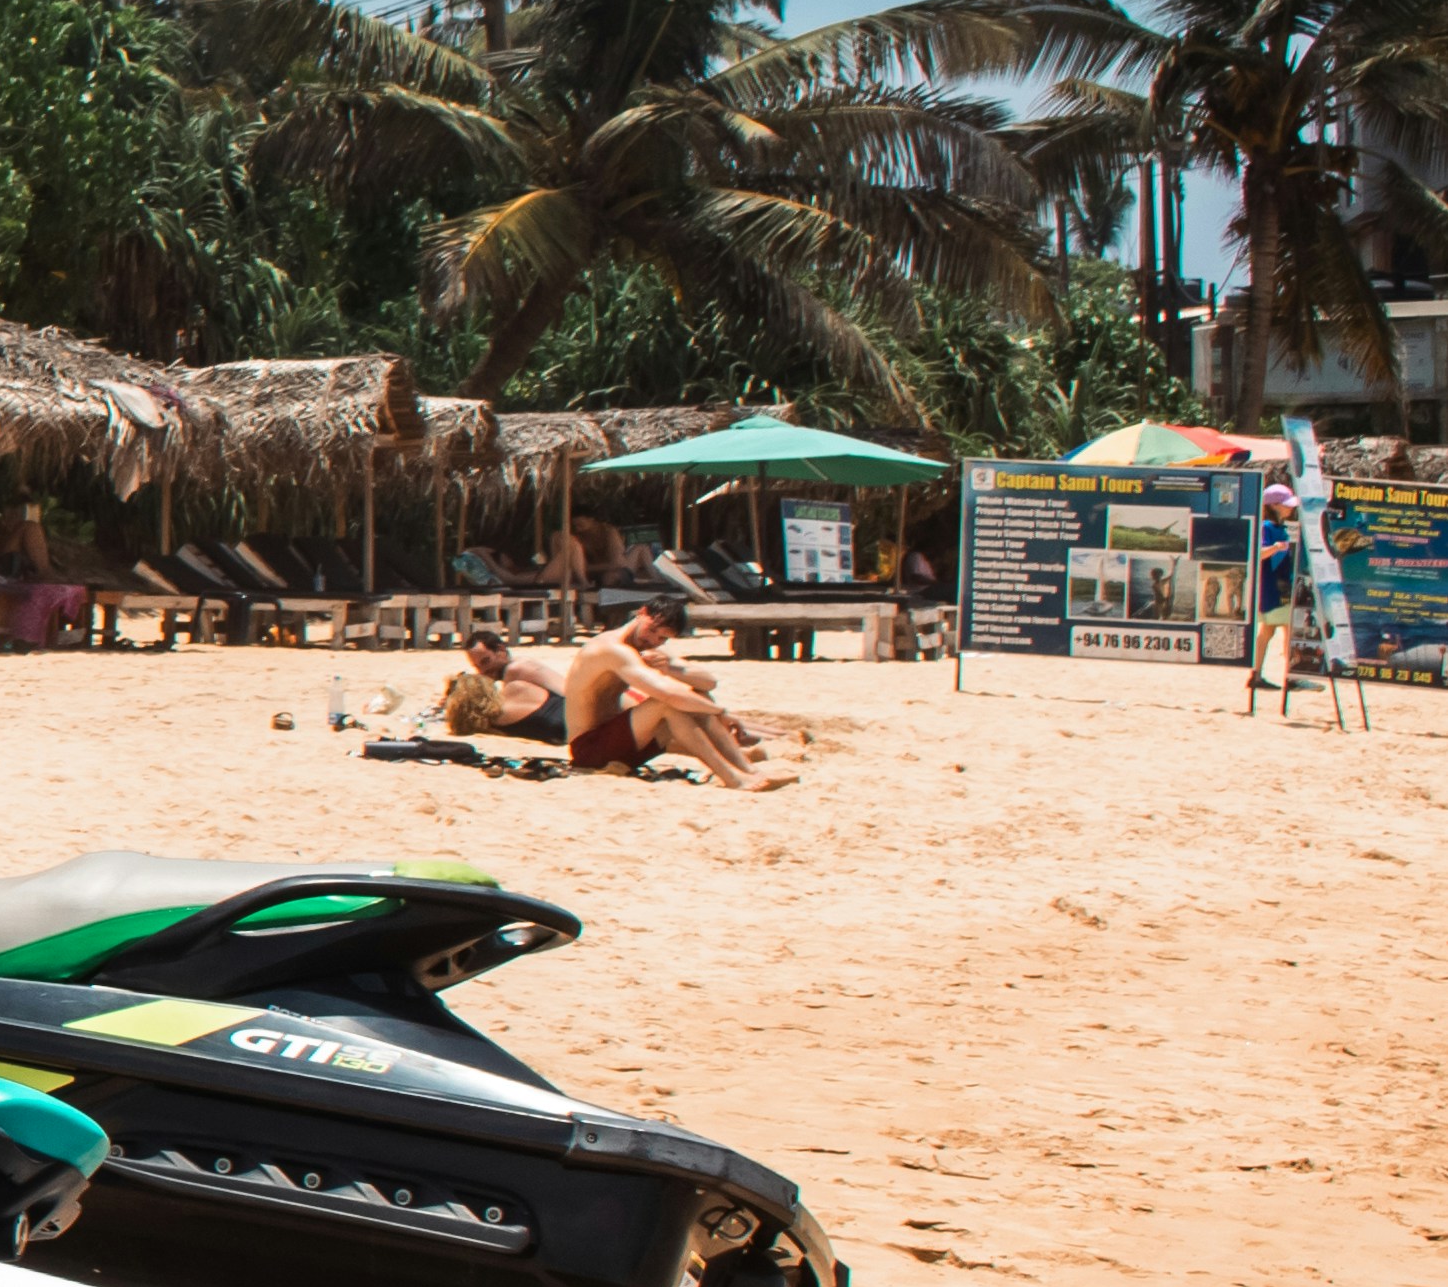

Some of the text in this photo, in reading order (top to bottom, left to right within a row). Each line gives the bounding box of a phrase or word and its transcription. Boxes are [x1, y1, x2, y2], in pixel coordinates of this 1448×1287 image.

[996, 472, 1055, 490] Captain
[1058, 474, 1097, 492] Sami
[1100, 475, 1144, 493] Tours
[1336, 483, 1384, 501] Captain
[1385, 487, 1418, 505] Sami
[1075, 633, 1192, 652] +94 76 96 230 45
[230, 1028, 342, 1064] GTI
[331, 1055, 392, 1074] 130
